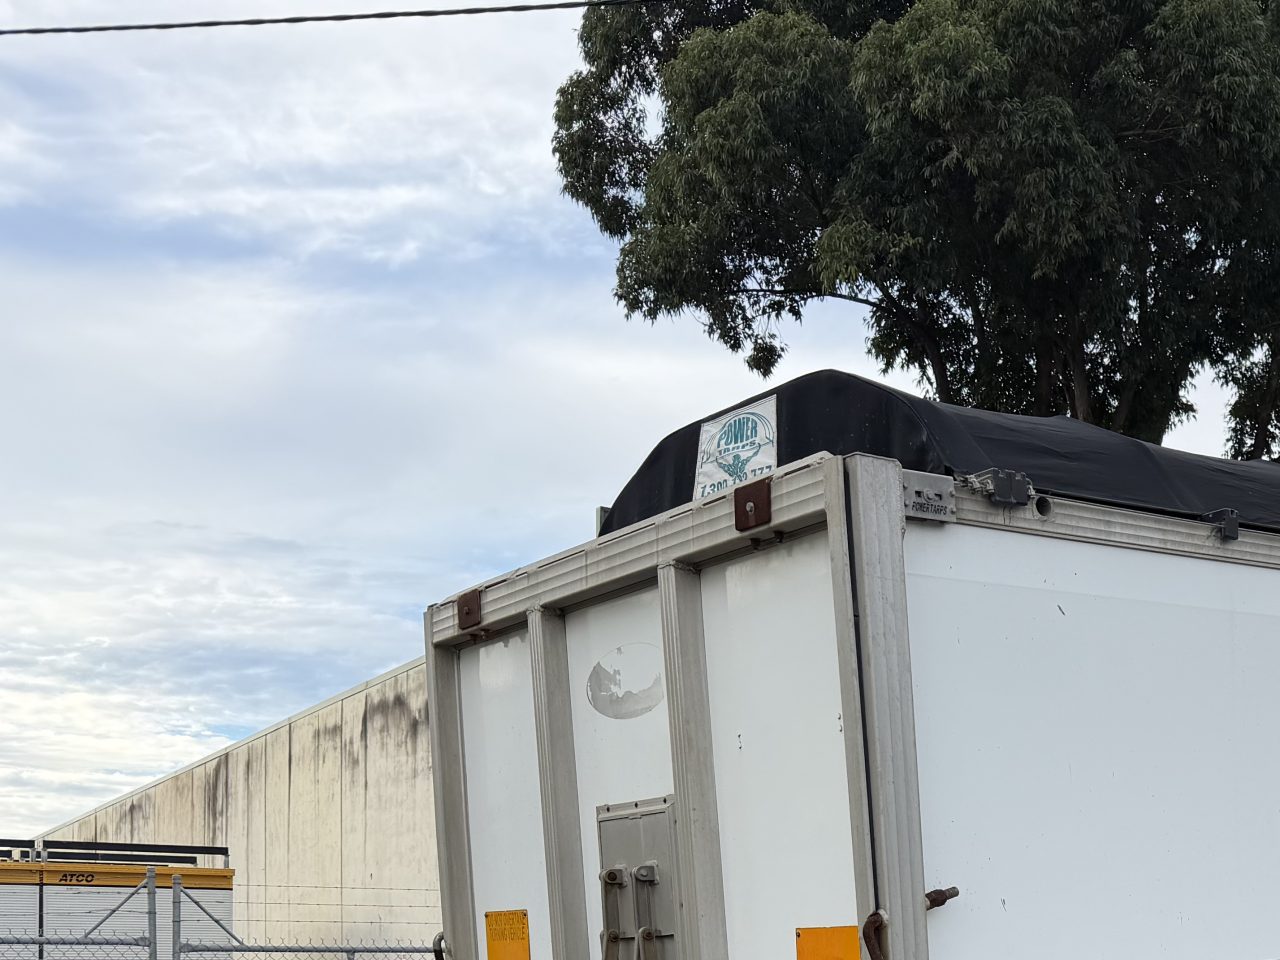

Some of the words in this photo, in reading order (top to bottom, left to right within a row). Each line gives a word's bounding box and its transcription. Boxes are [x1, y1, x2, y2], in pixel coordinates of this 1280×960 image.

[717, 416, 758, 449] POWER
[911, 501, 948, 516] POWERTARPS
[58, 873, 95, 883] ATCO
